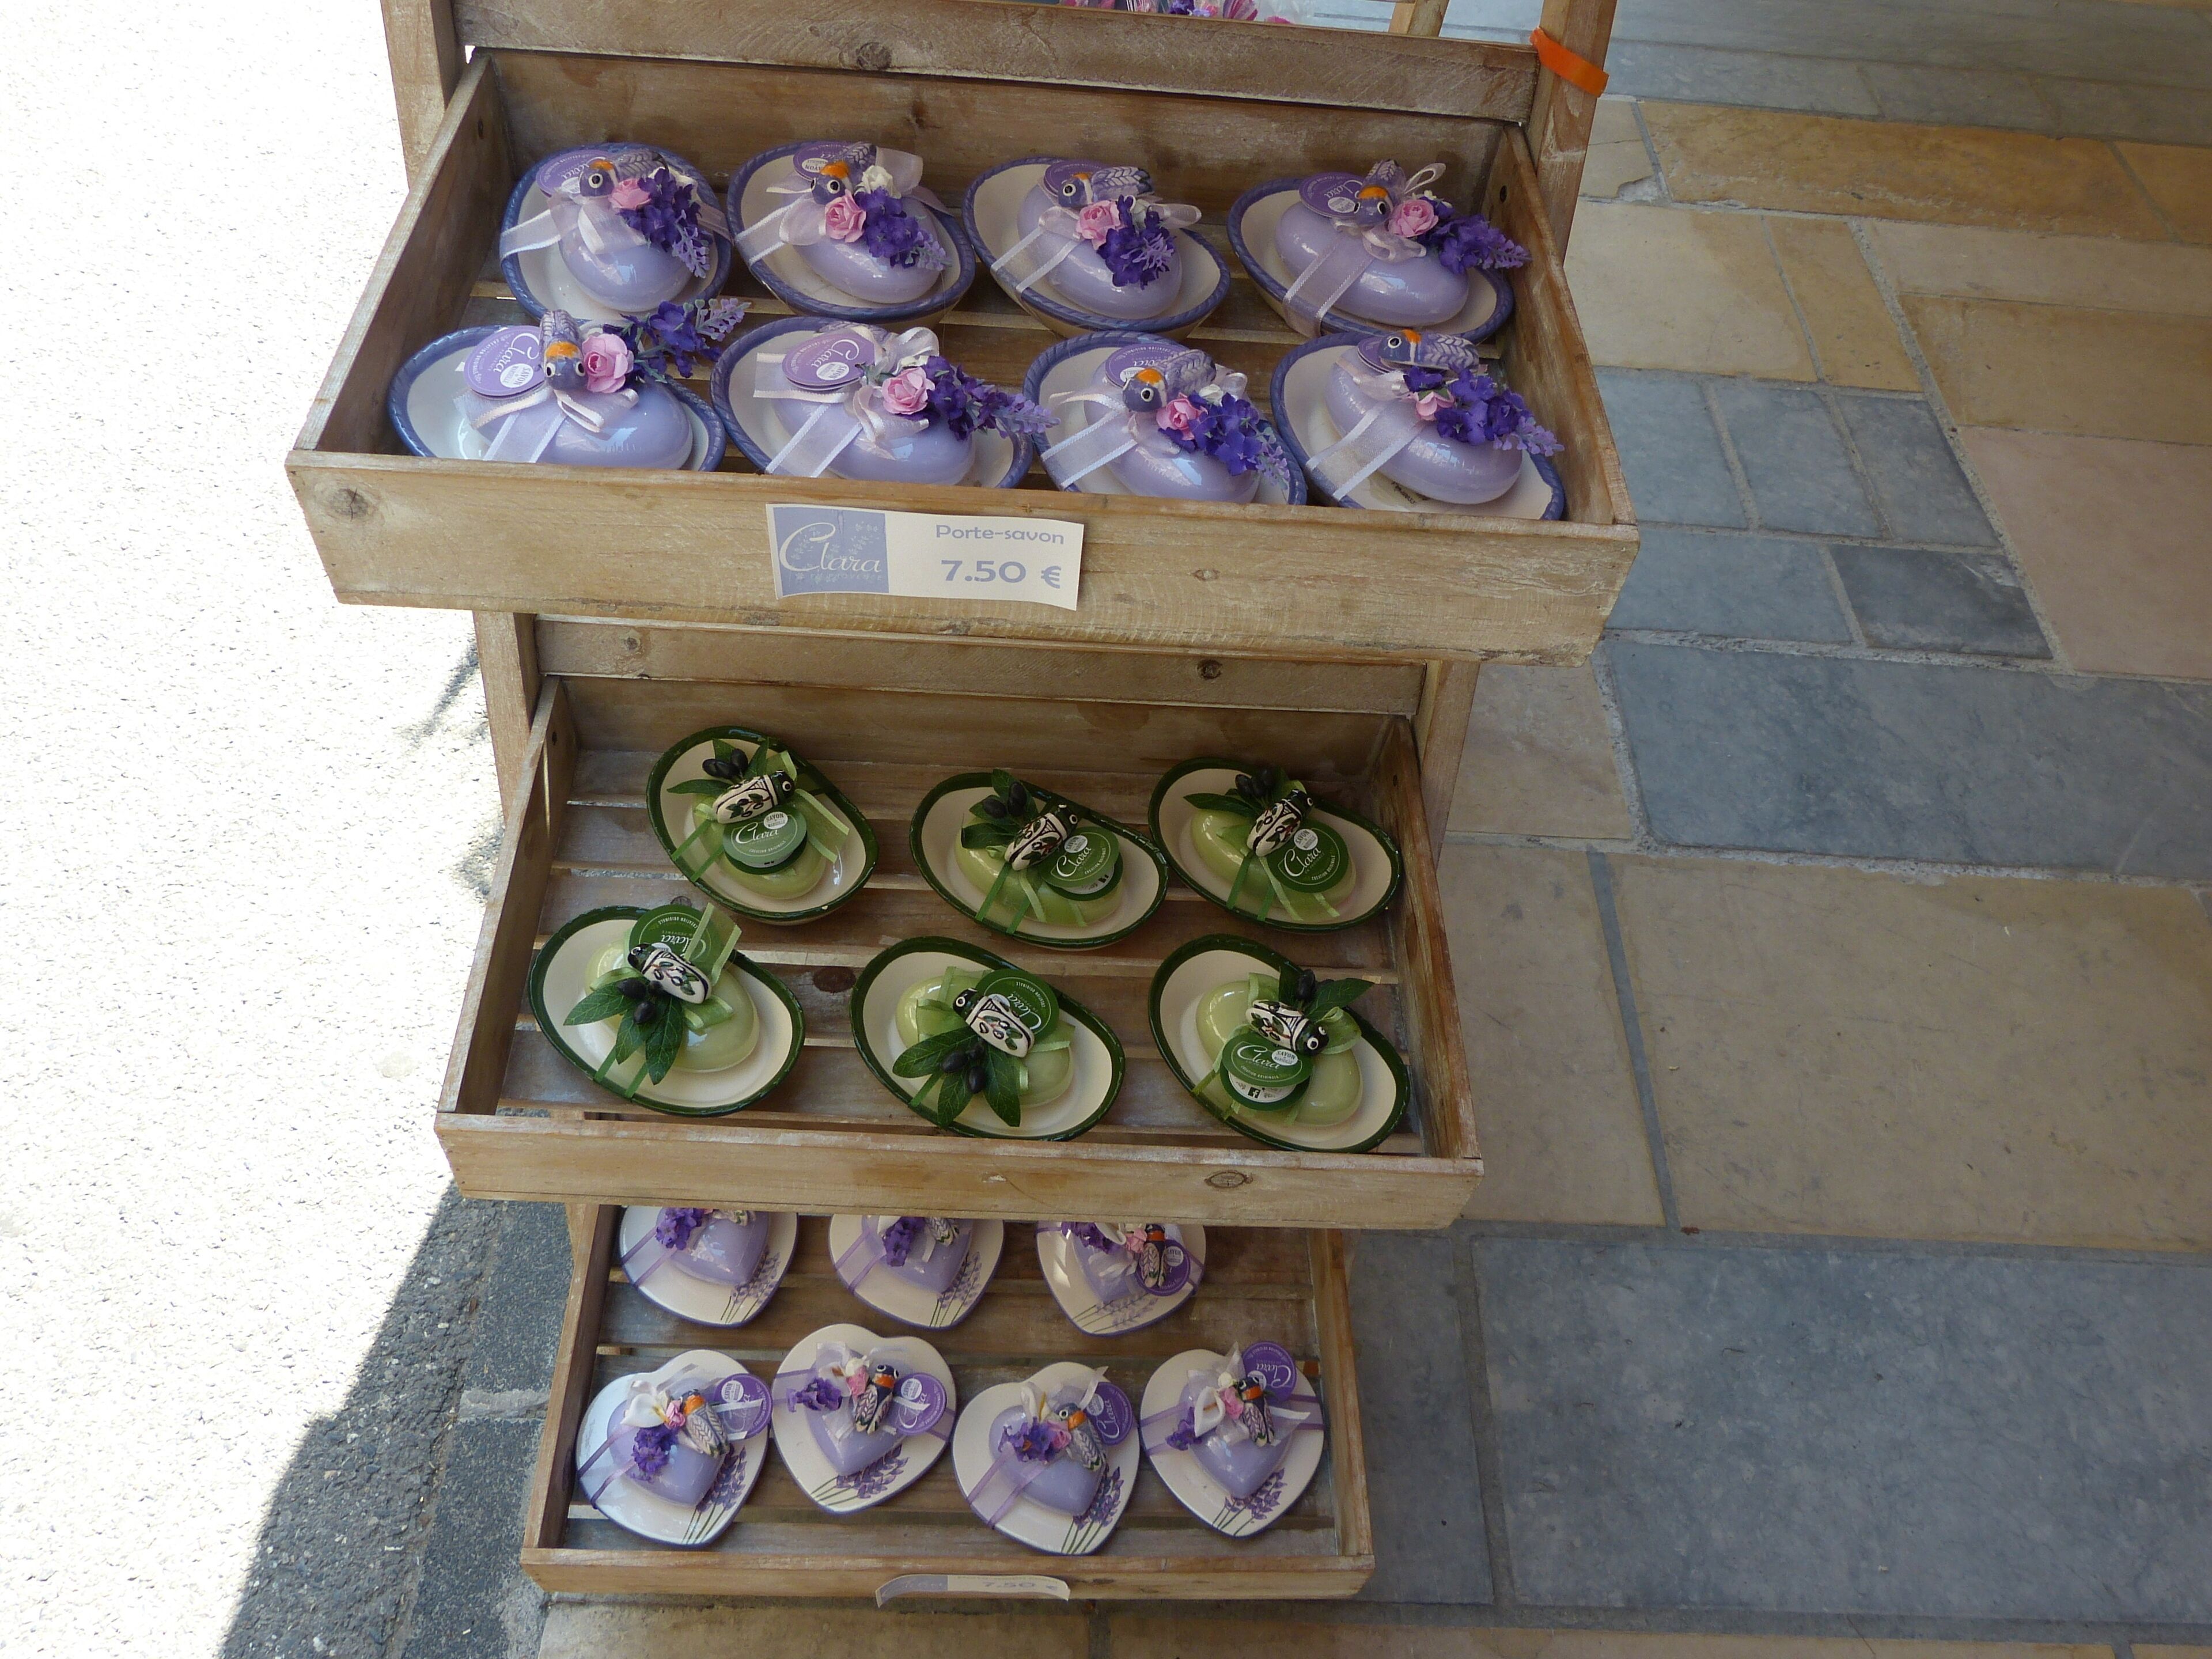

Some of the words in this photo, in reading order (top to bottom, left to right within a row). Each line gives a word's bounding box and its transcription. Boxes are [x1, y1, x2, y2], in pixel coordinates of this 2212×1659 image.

[493, 332, 540, 373] Clara
[811, 339, 859, 368] Clara
[779, 522, 882, 573] Clara
[936, 524, 1064, 544] Porte-savon
[941, 559, 1027, 583] 7.50
[1041, 565, 1062, 589] €
[766, 813, 784, 821] SAVON
[736, 821, 779, 844] Clara
[1296, 830, 1310, 844] SAVON
[1056, 847, 1092, 877] Clara
[1284, 847, 1321, 877] Clara
[1237, 1044, 1281, 1069] Clara
[1277, 1050, 1296, 1060] SAVON
[1256, 1363, 1291, 1389] Clara
[1096, 1399, 1120, 1439] Clara
